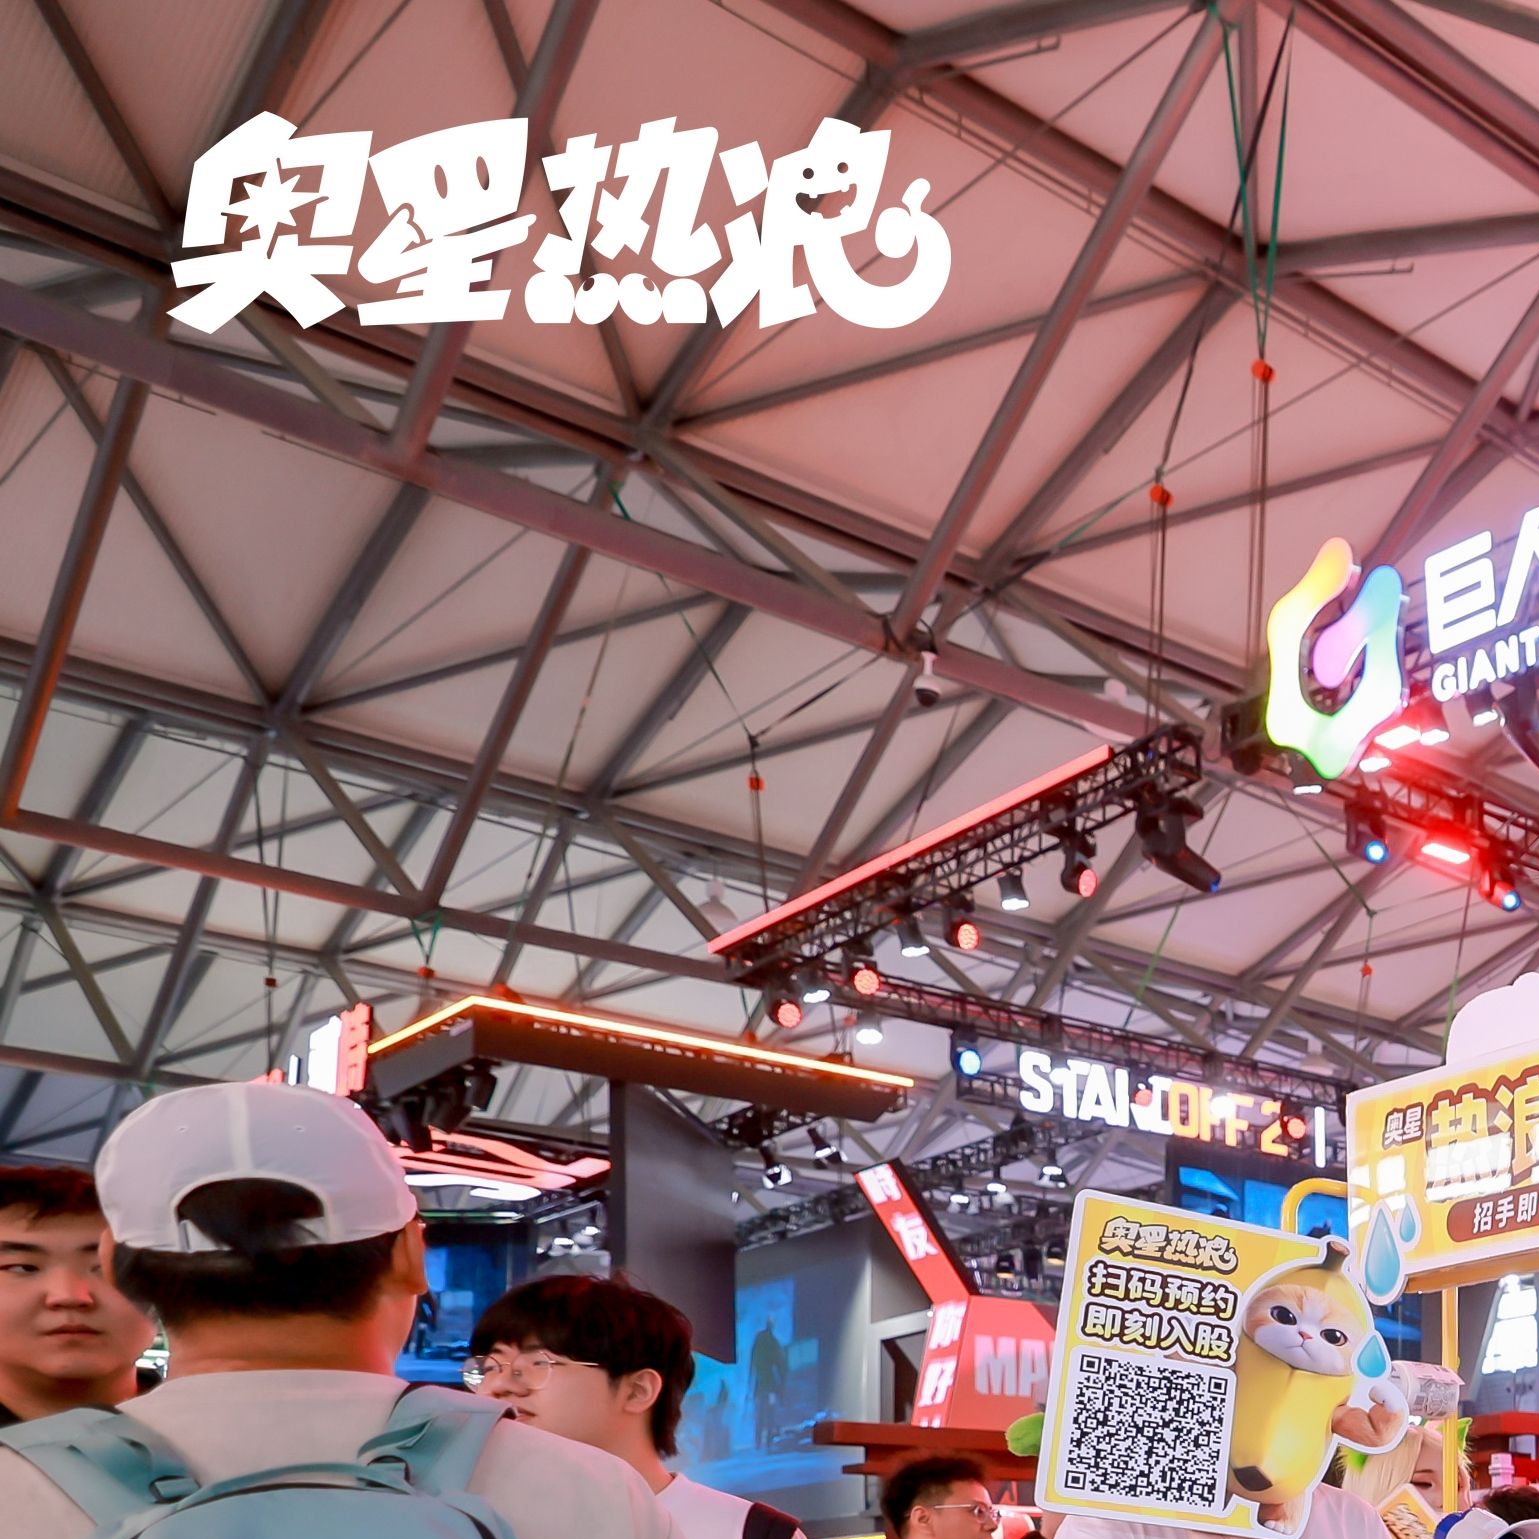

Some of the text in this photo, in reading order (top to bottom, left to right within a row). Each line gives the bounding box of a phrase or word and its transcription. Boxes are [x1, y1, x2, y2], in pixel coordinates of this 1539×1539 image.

[1019, 1050, 1289, 1157] STANDOFF 2
[1384, 1105, 1424, 1146] 奥星
[1099, 1216, 1238, 1273] 奥星热浪
[1091, 1263, 1236, 1318] 扫码预约
[1084, 1304, 1232, 1360] 即刻入股
[974, 1333, 1056, 1397] MA
